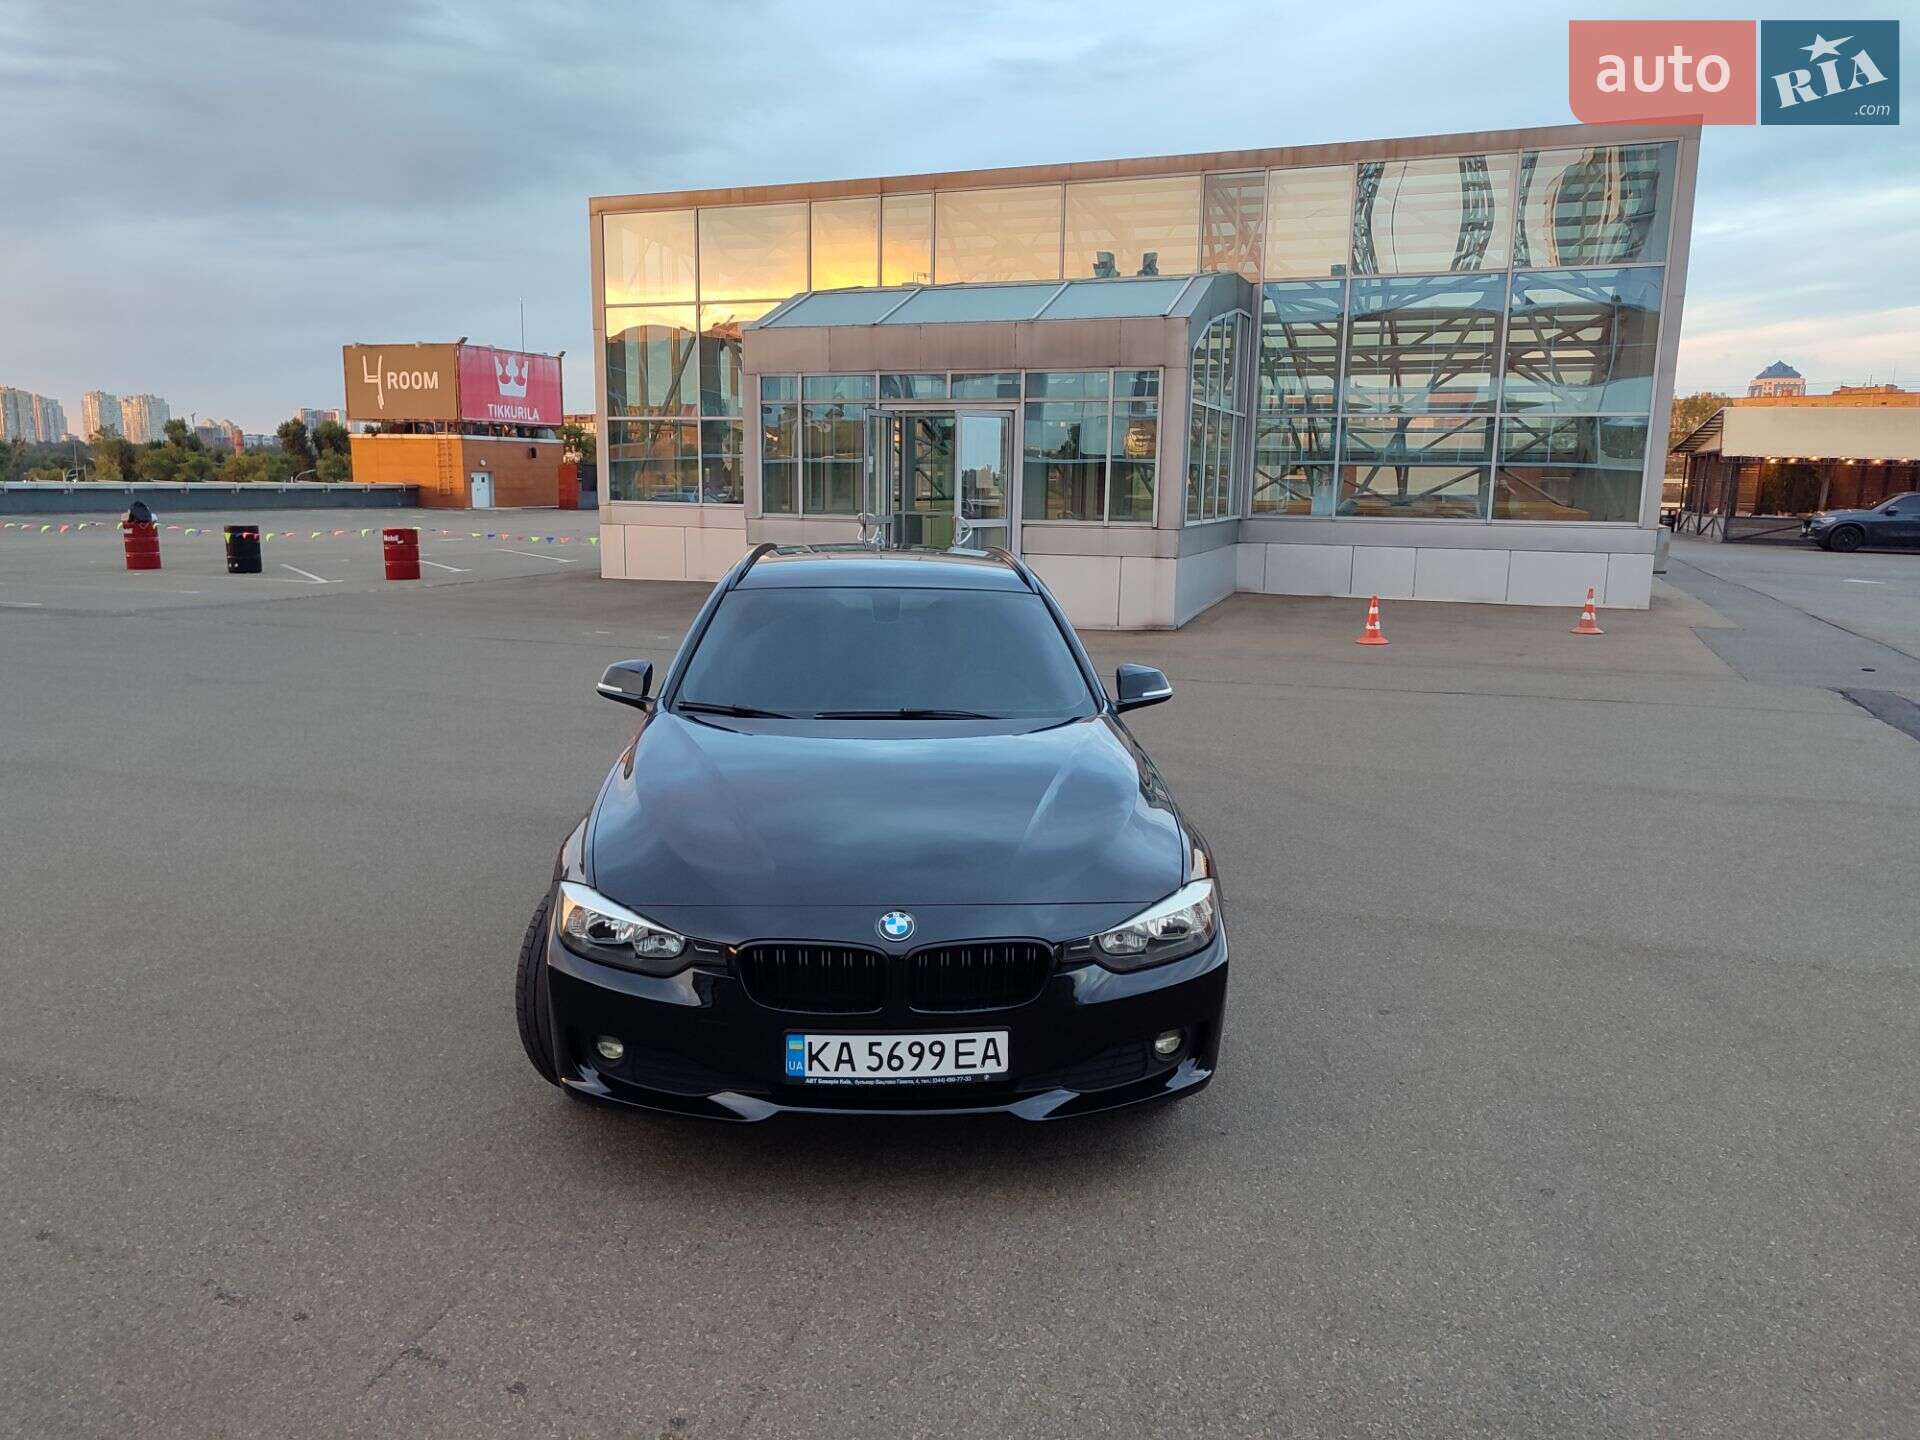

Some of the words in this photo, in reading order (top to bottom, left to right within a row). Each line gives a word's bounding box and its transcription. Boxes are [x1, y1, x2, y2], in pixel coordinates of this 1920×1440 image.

[387, 371, 439, 390] ROOM
[487, 403, 540, 421] TIKKURILA
[807, 1041, 857, 1072] KA
[866, 1040, 946, 1072] 5699
[954, 1037, 1002, 1070] EA
[788, 1061, 803, 1071] UA
